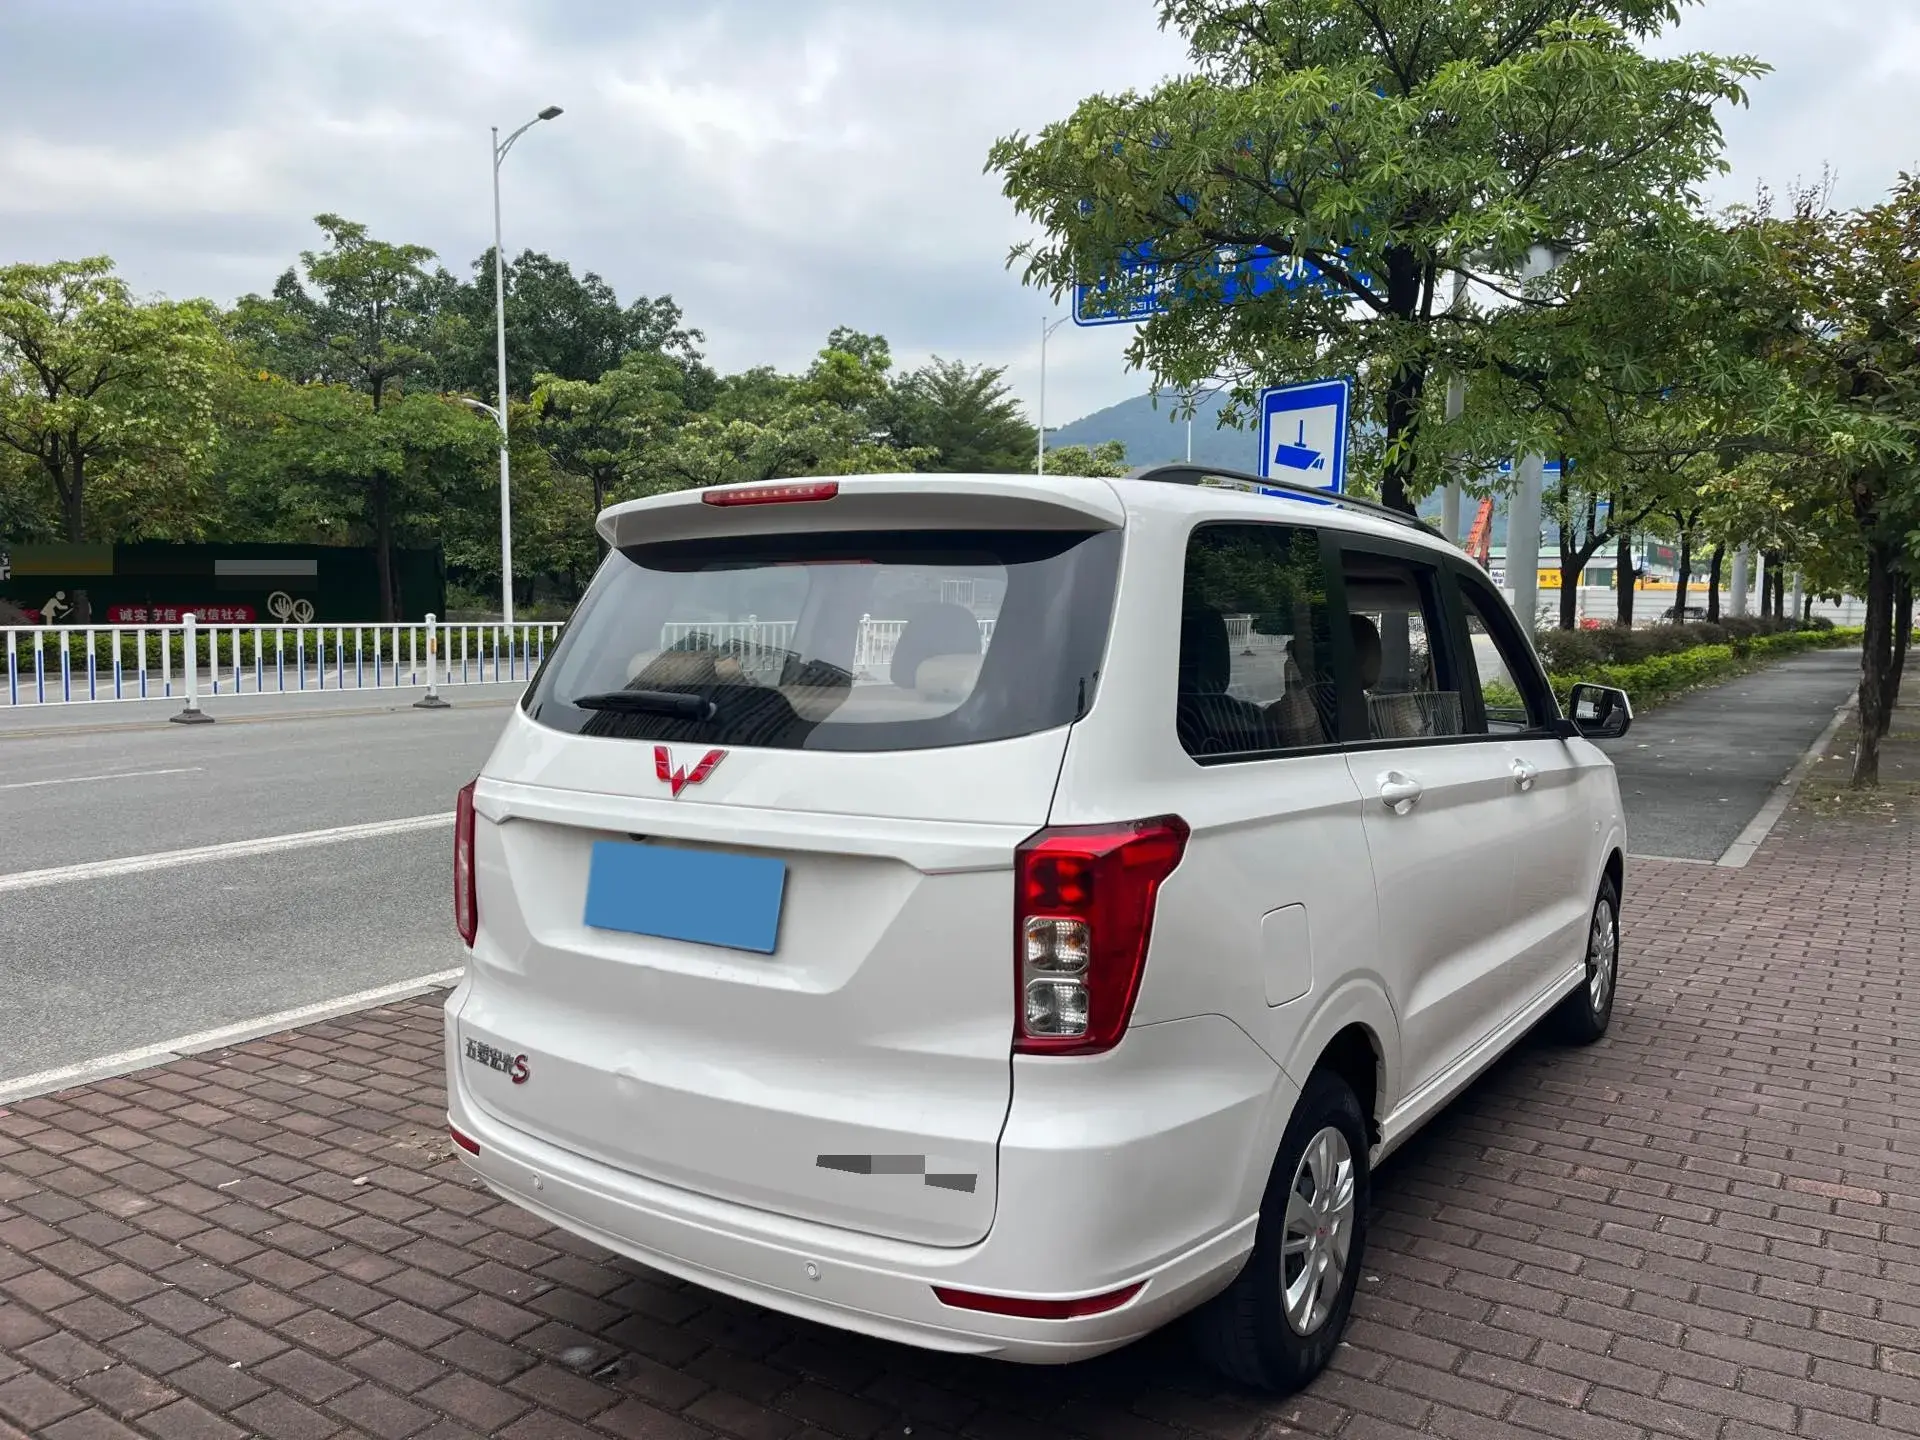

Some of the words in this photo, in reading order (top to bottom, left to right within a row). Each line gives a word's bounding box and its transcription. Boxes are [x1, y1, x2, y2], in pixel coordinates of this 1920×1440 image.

[119, 608, 177, 622] 诚实守信
[193, 608, 247, 620] 诚信社会
